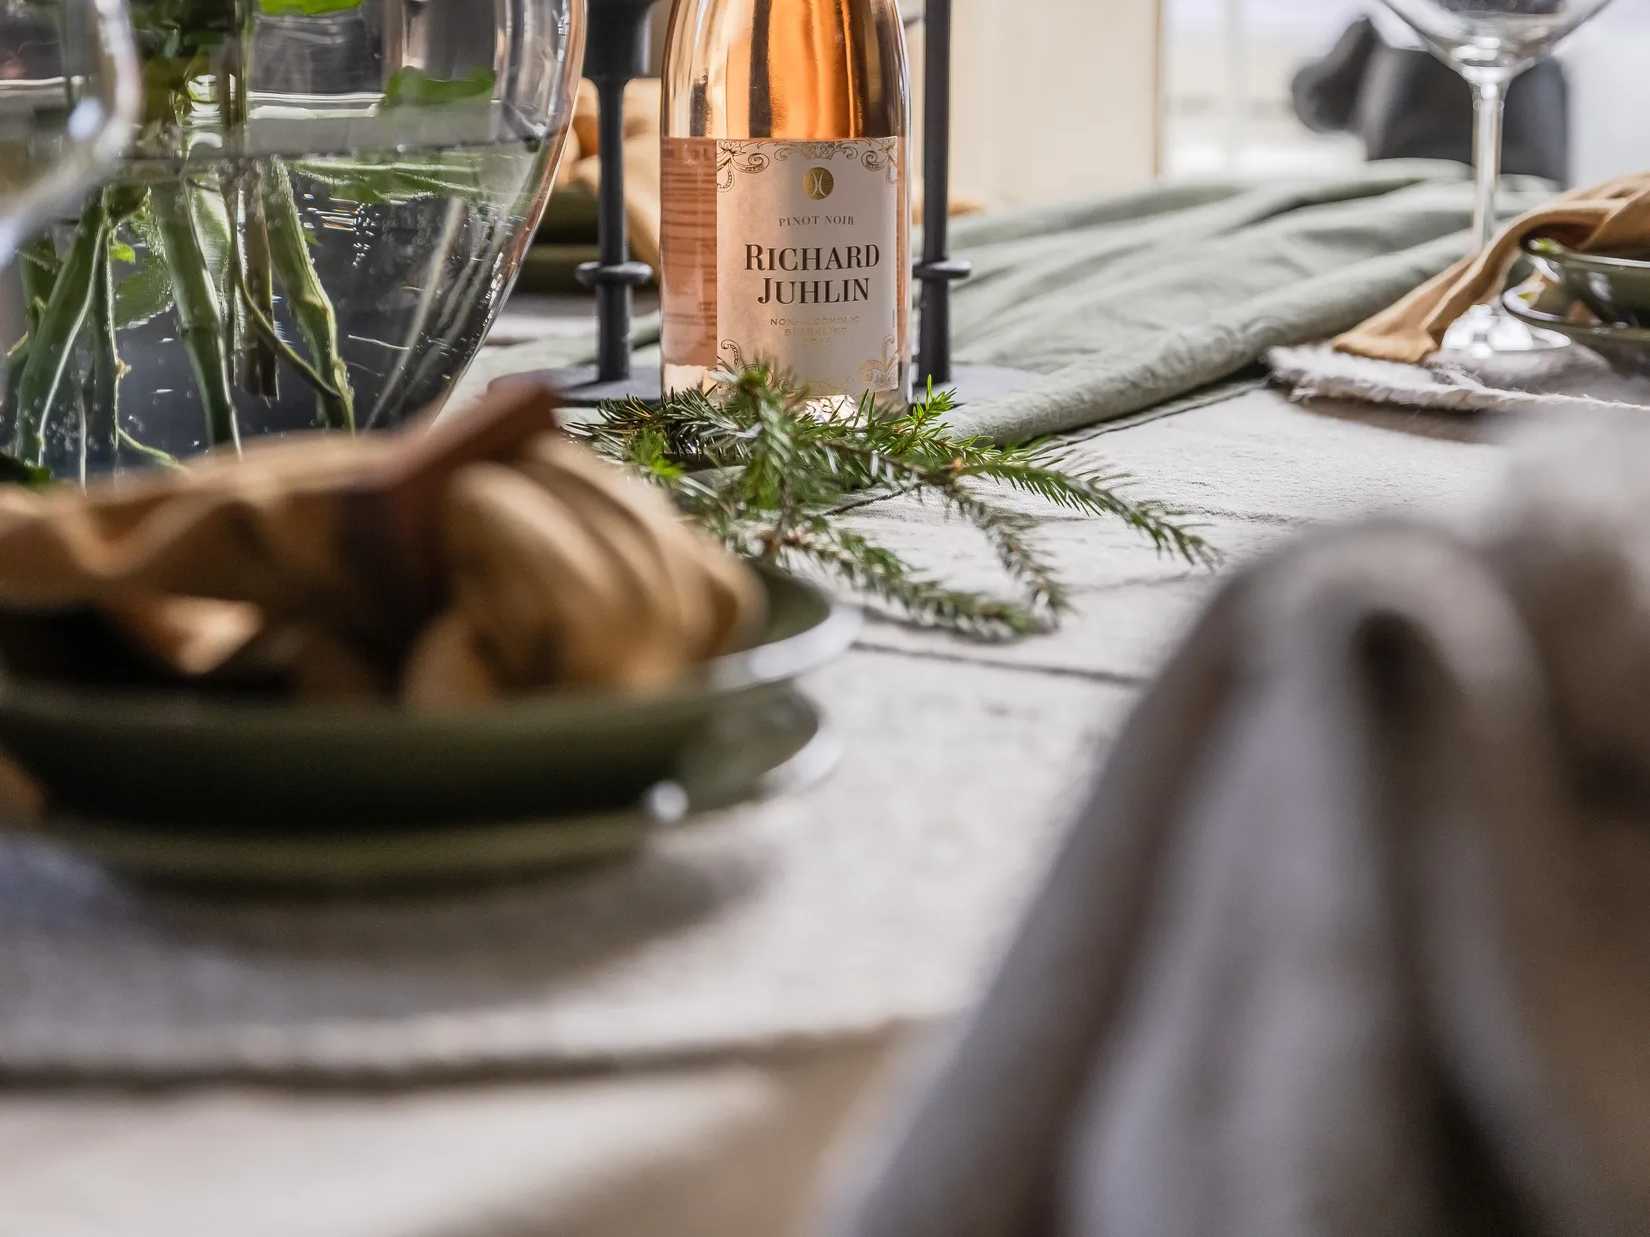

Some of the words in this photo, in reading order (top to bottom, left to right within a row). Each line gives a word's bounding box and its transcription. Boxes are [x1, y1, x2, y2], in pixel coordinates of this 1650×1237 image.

[779, 216, 819, 227] PINOT
[825, 215, 855, 225] NOIR
[744, 243, 880, 271] RICHARD
[757, 277, 870, 304] JUHLIN
